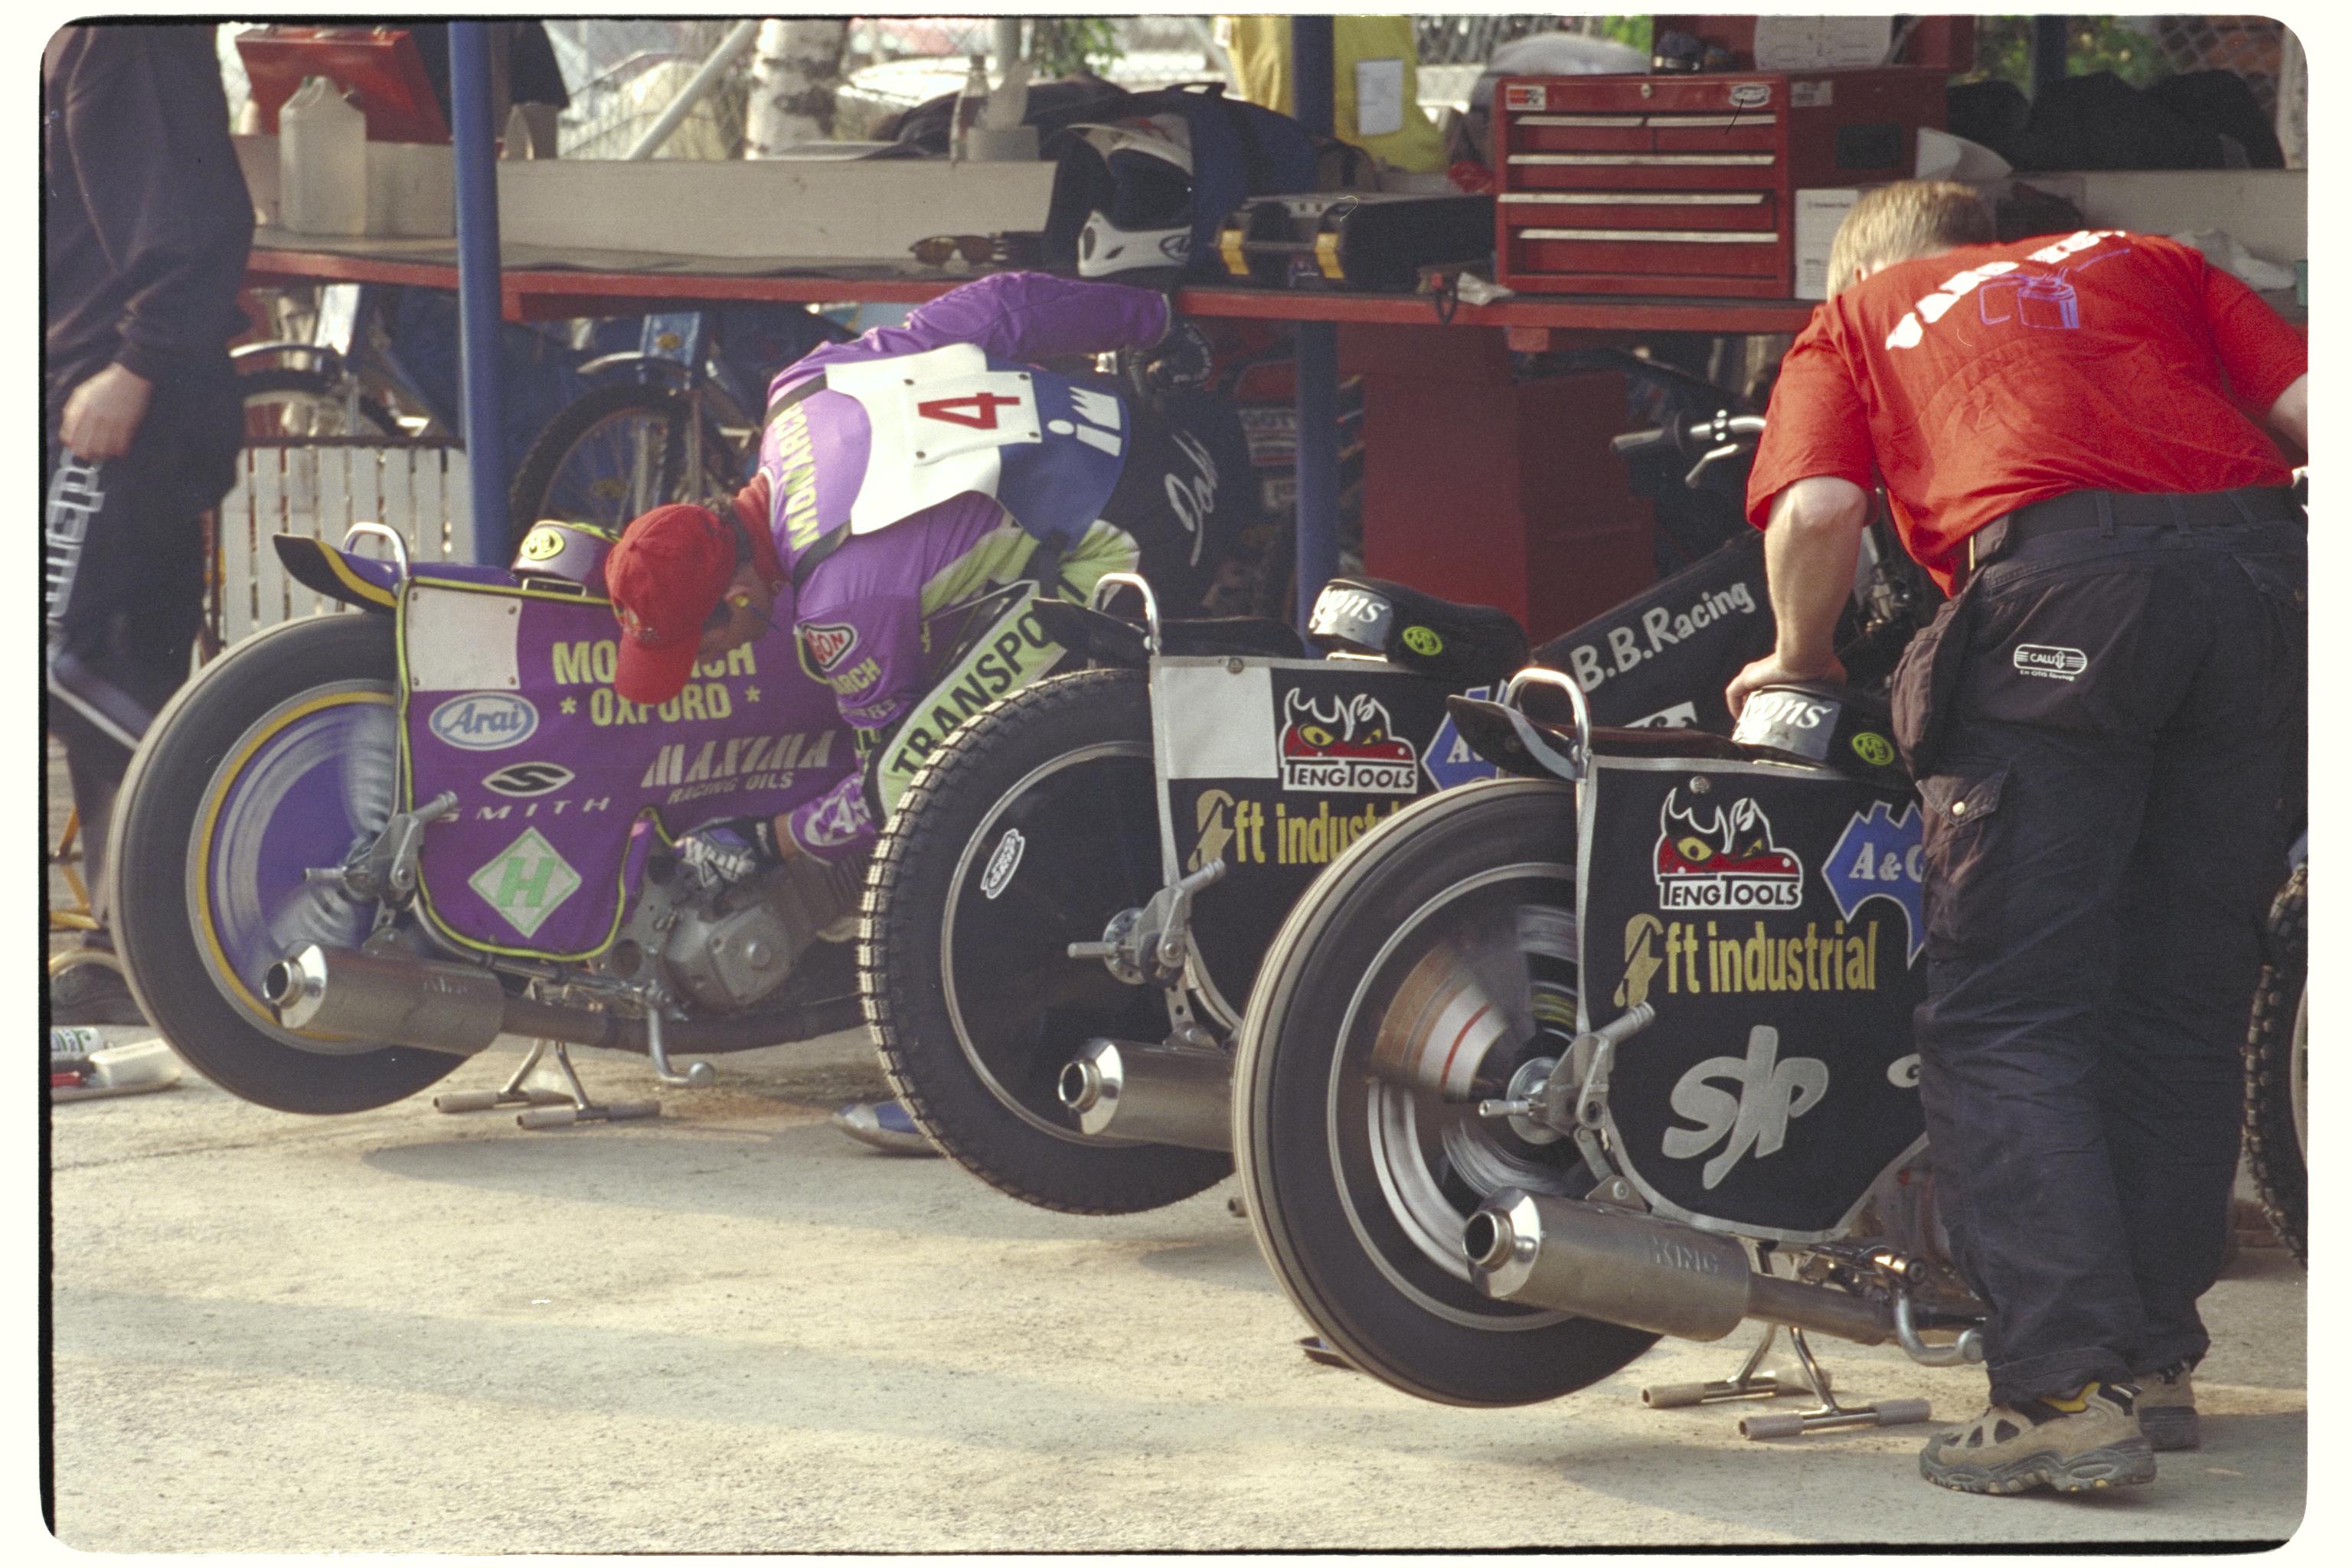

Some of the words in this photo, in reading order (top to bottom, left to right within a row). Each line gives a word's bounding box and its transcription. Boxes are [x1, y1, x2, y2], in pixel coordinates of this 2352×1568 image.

[918, 393, 1021, 430] 4
[442, 702, 521, 734] Arai
[641, 730, 836, 788] MAXIMA
[668, 777, 738, 804] RACING
[745, 768, 794, 792] OILS
[1666, 922, 1700, 994] ft
[1708, 921, 1878, 992] industrial
